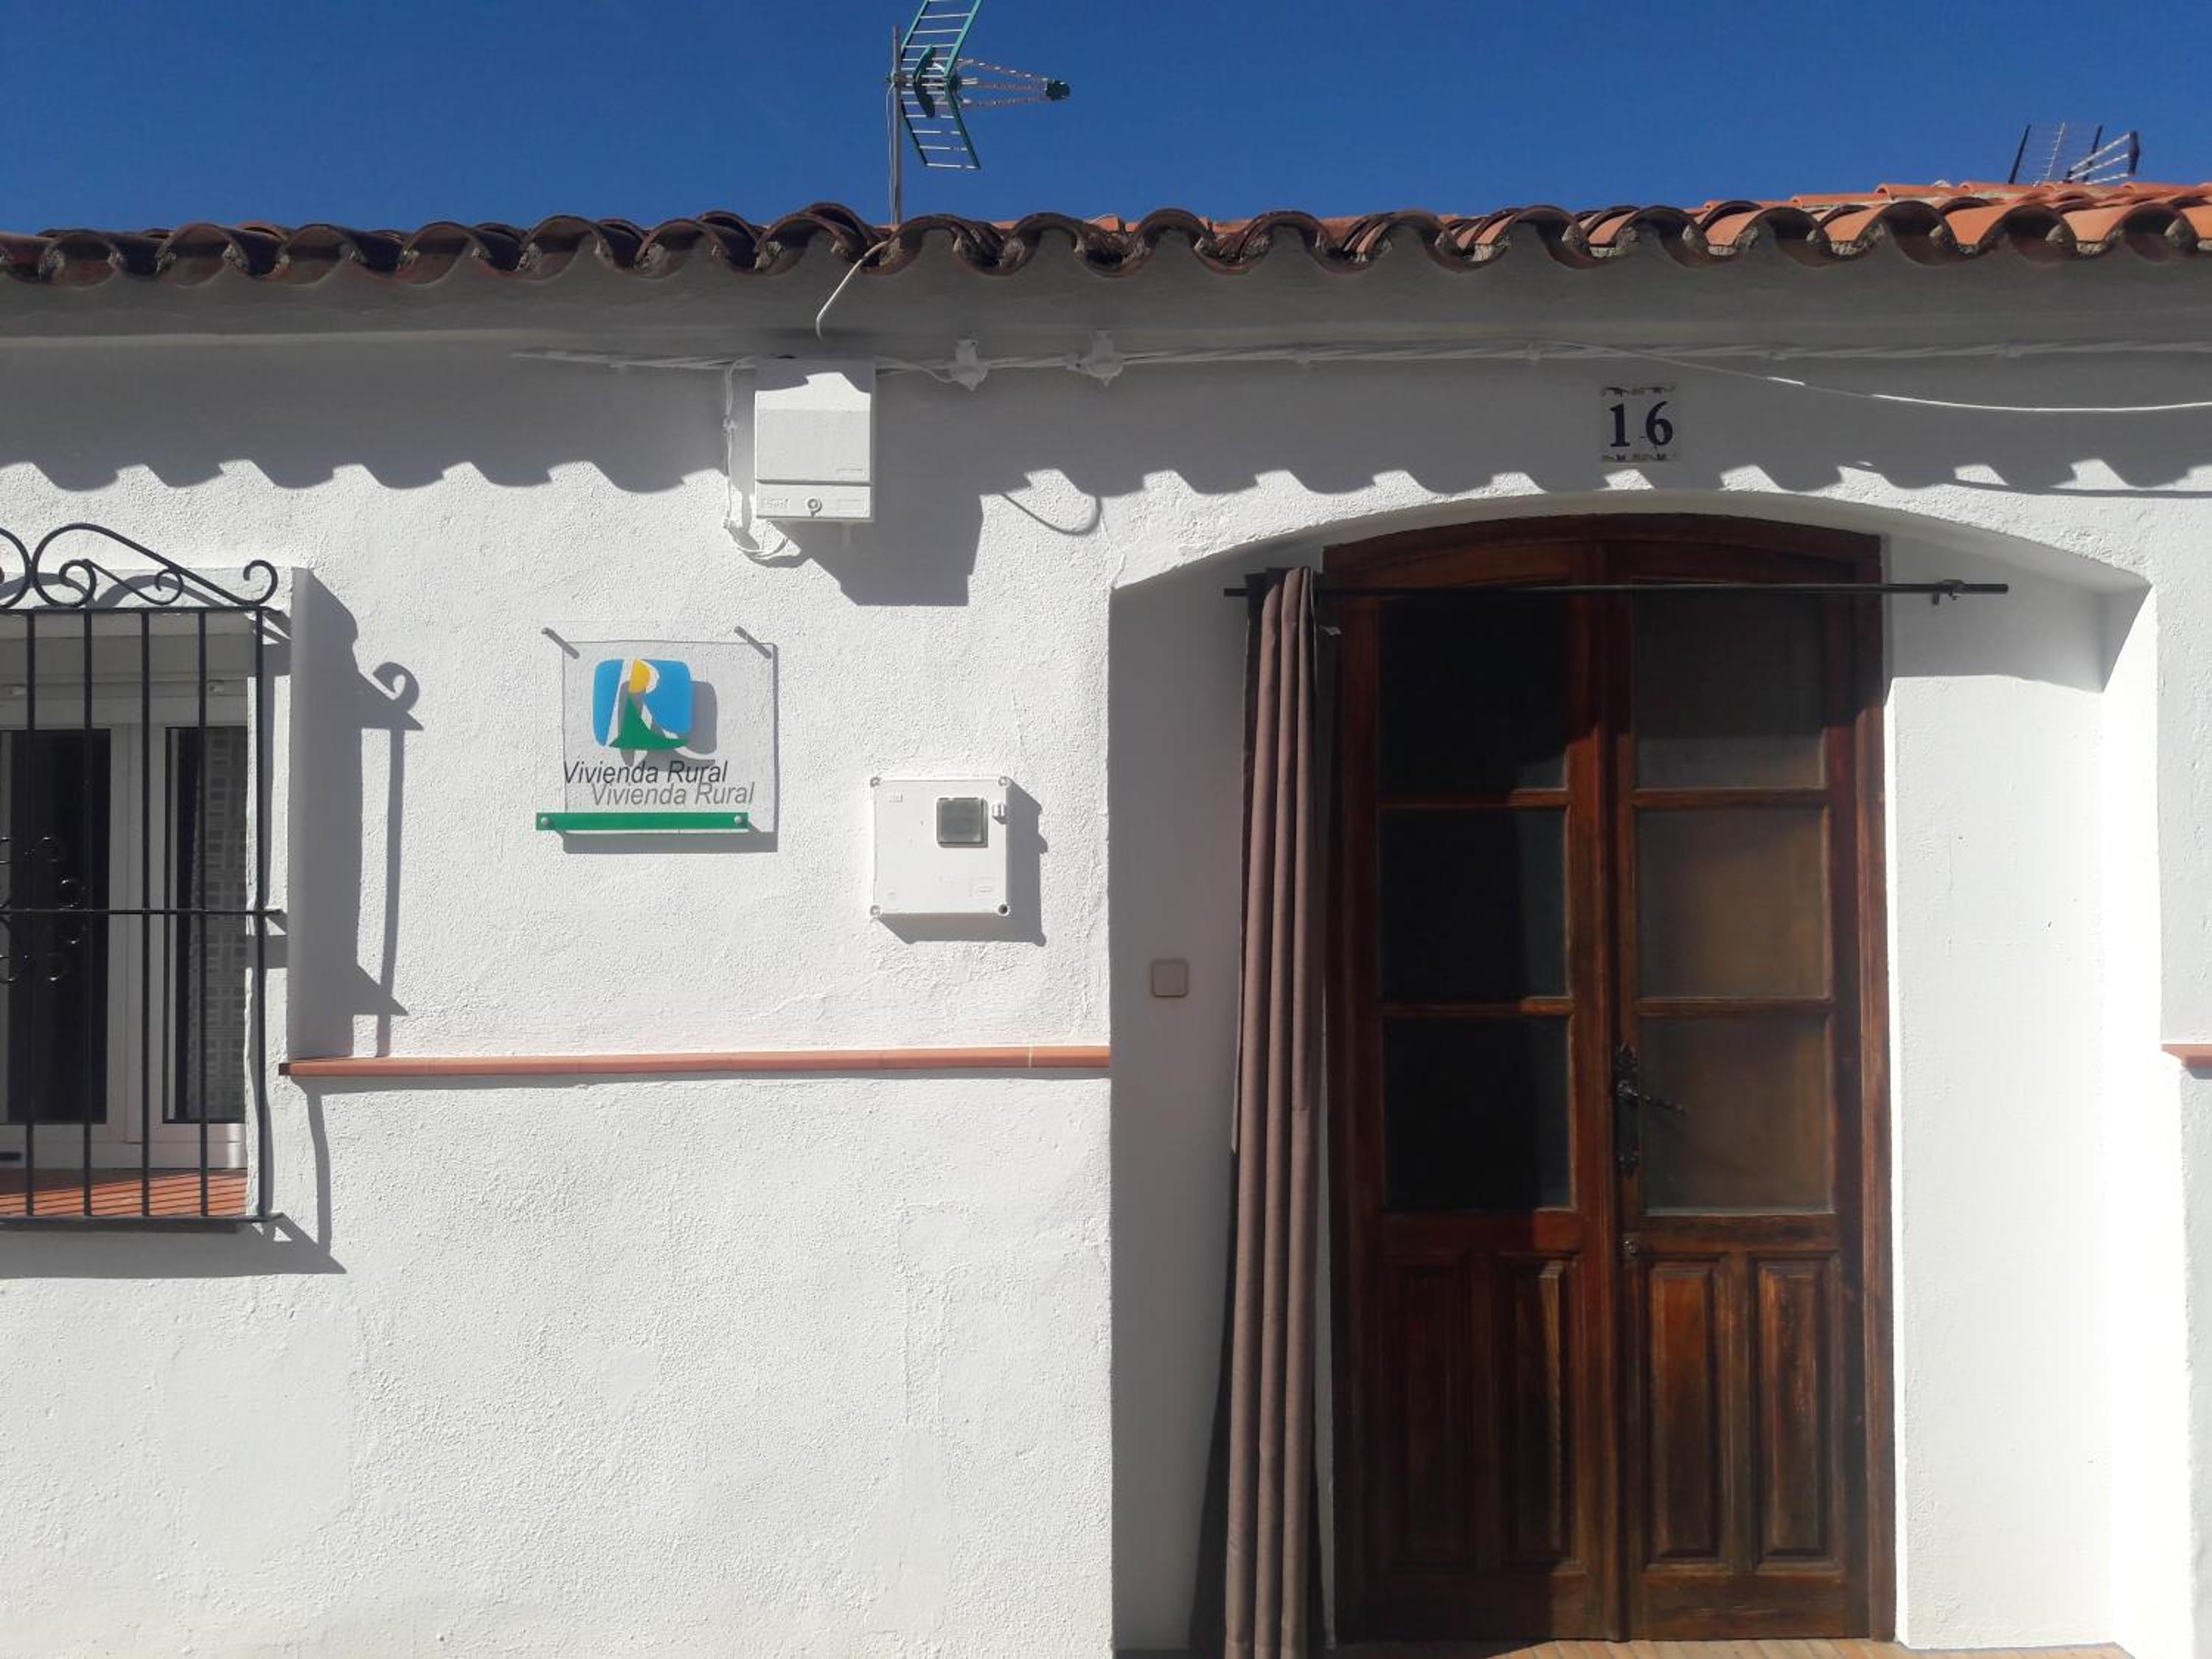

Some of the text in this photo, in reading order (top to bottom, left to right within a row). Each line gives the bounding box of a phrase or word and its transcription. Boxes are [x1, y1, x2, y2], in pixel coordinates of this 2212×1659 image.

[1610, 400, 1674, 448] 16
[564, 760, 728, 784] Vivienda Rural
[591, 782, 755, 805] Vivienda Rural
